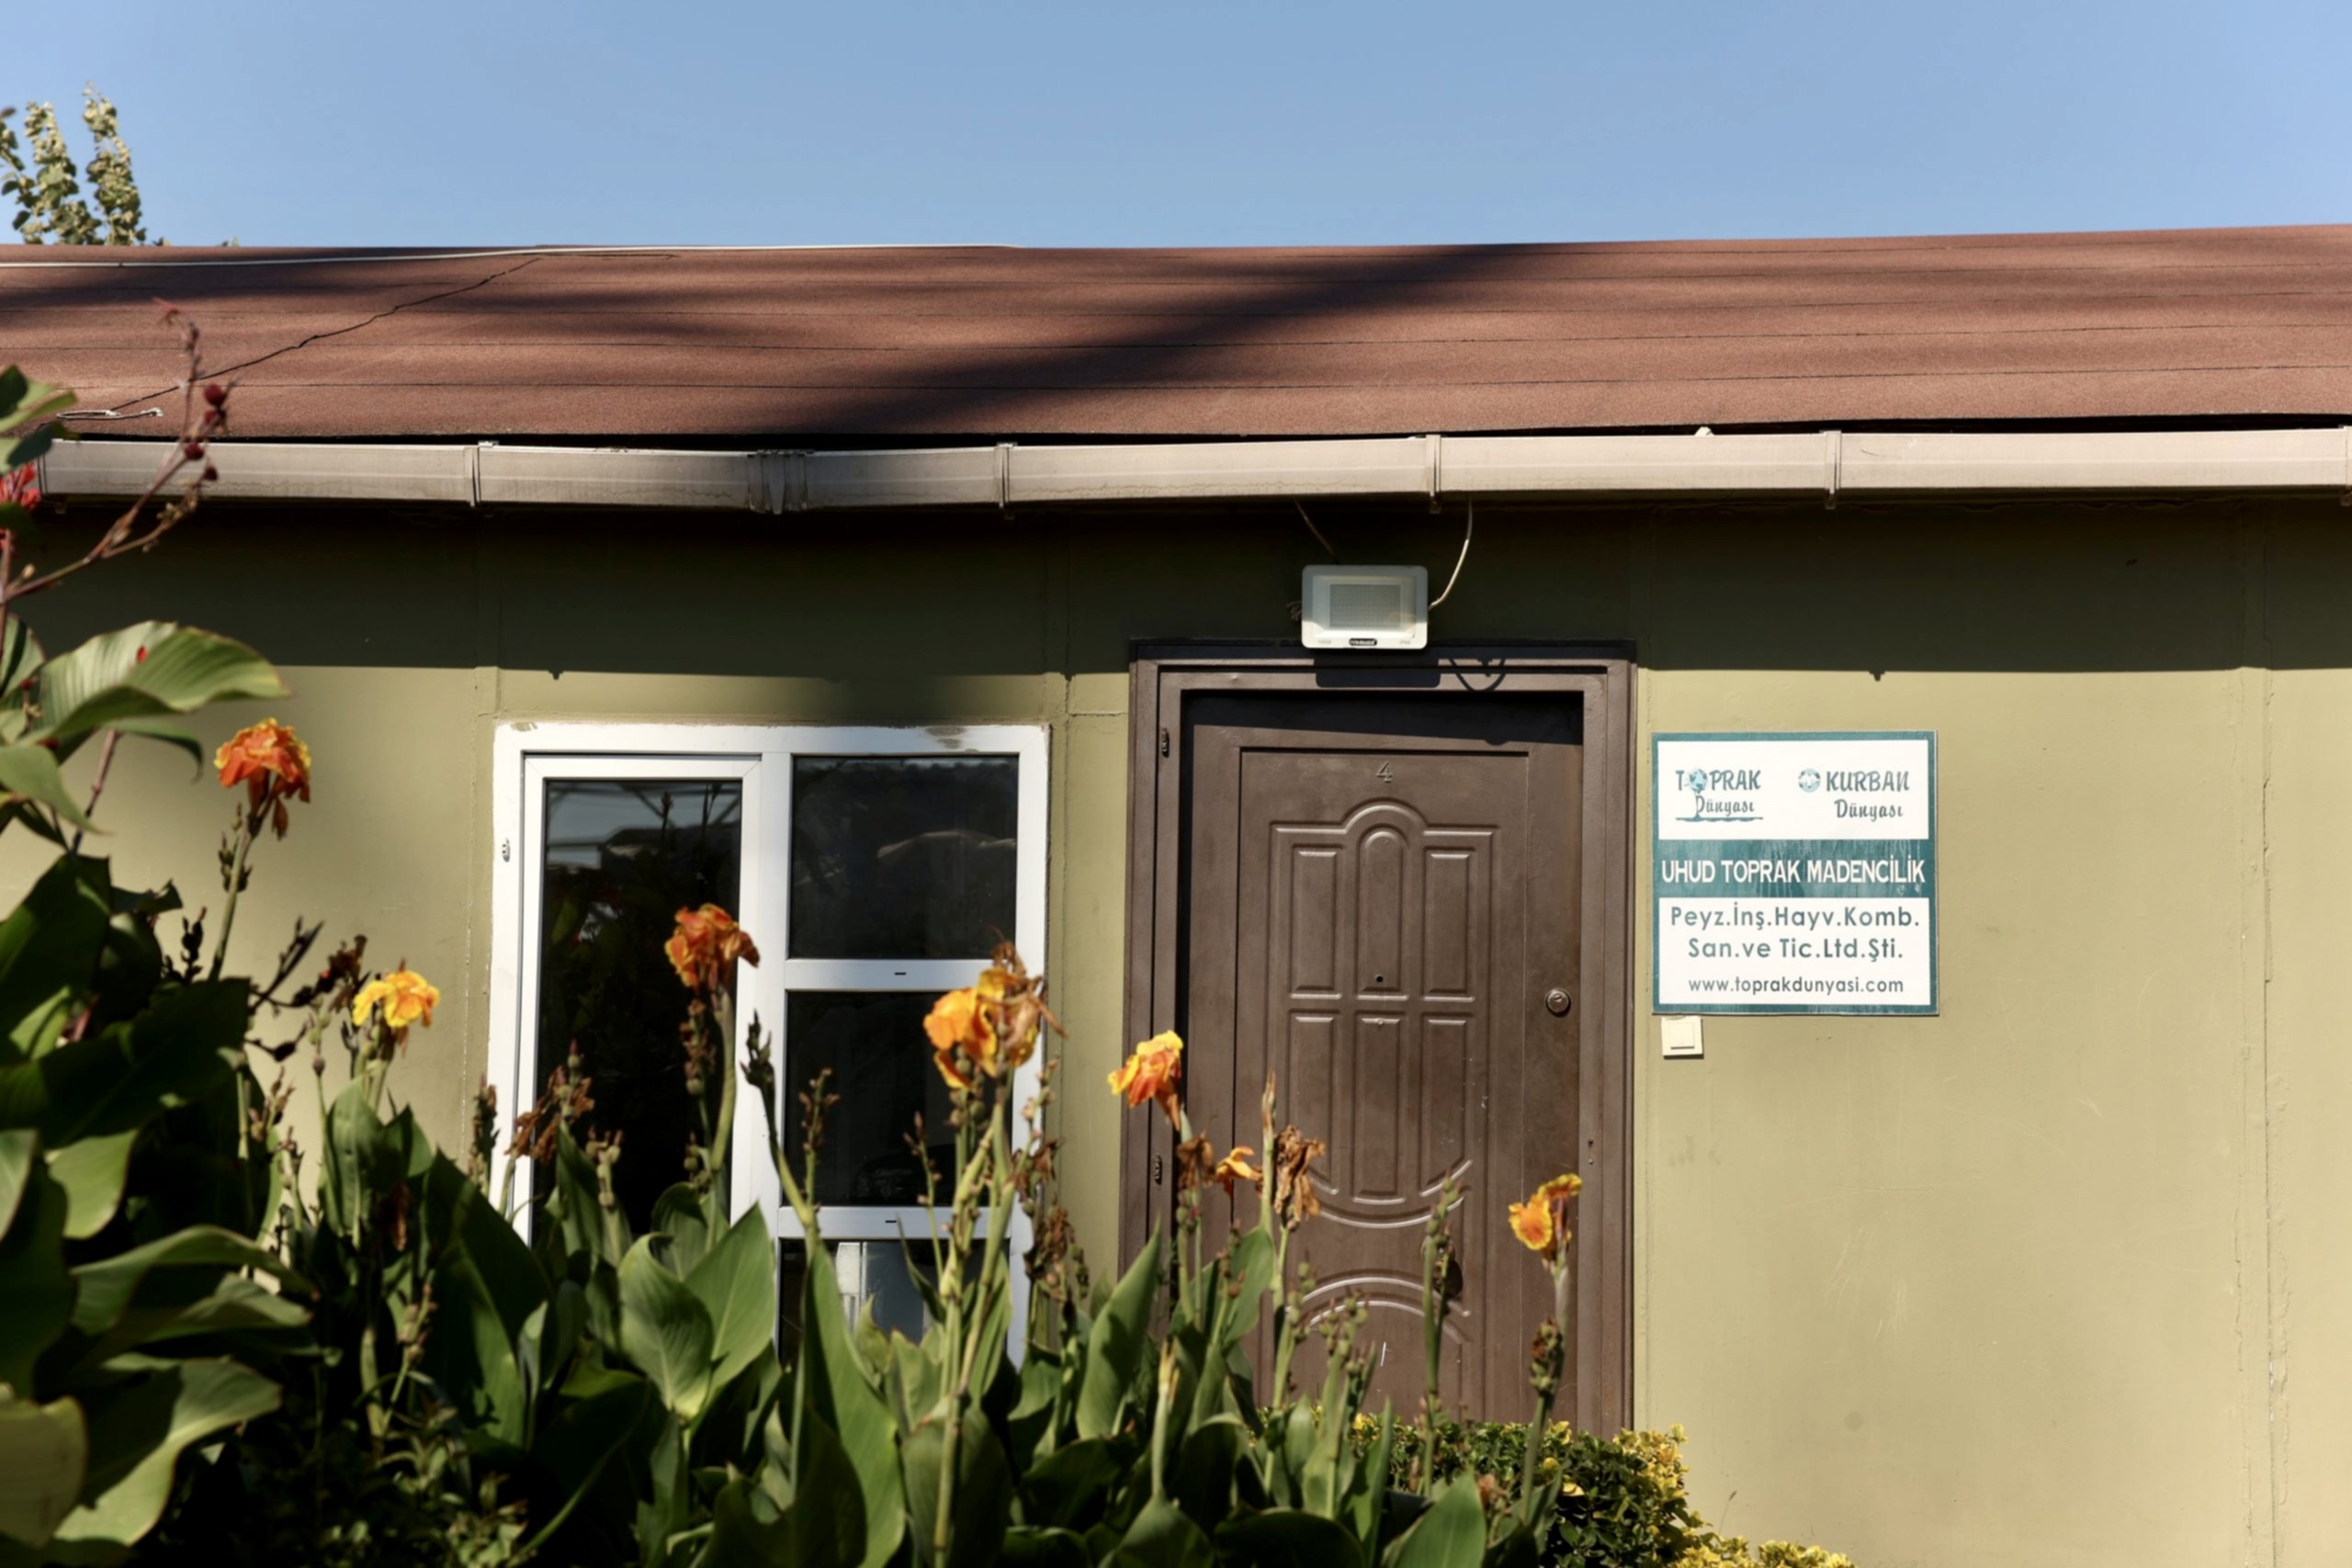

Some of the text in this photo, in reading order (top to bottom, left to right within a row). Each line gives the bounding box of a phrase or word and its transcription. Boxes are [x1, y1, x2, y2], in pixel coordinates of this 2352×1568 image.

[1375, 761, 1393, 784] 4
[1675, 768, 1762, 793] TOPRAK
[1826, 770, 1910, 793] KURBAN
[1696, 795, 1756, 817] Dünyası
[1834, 798, 1904, 822] Dünyası
[1661, 855, 1927, 884] UHUD TOPRAK MADENCİLİK
[1670, 902, 1920, 931] Peyz.İnş.Hayv.Komb.
[1688, 938, 1904, 963] San.ve Tic.Ltd.Şti.
[1688, 976, 1905, 997] www.toprakdunyasi.com
